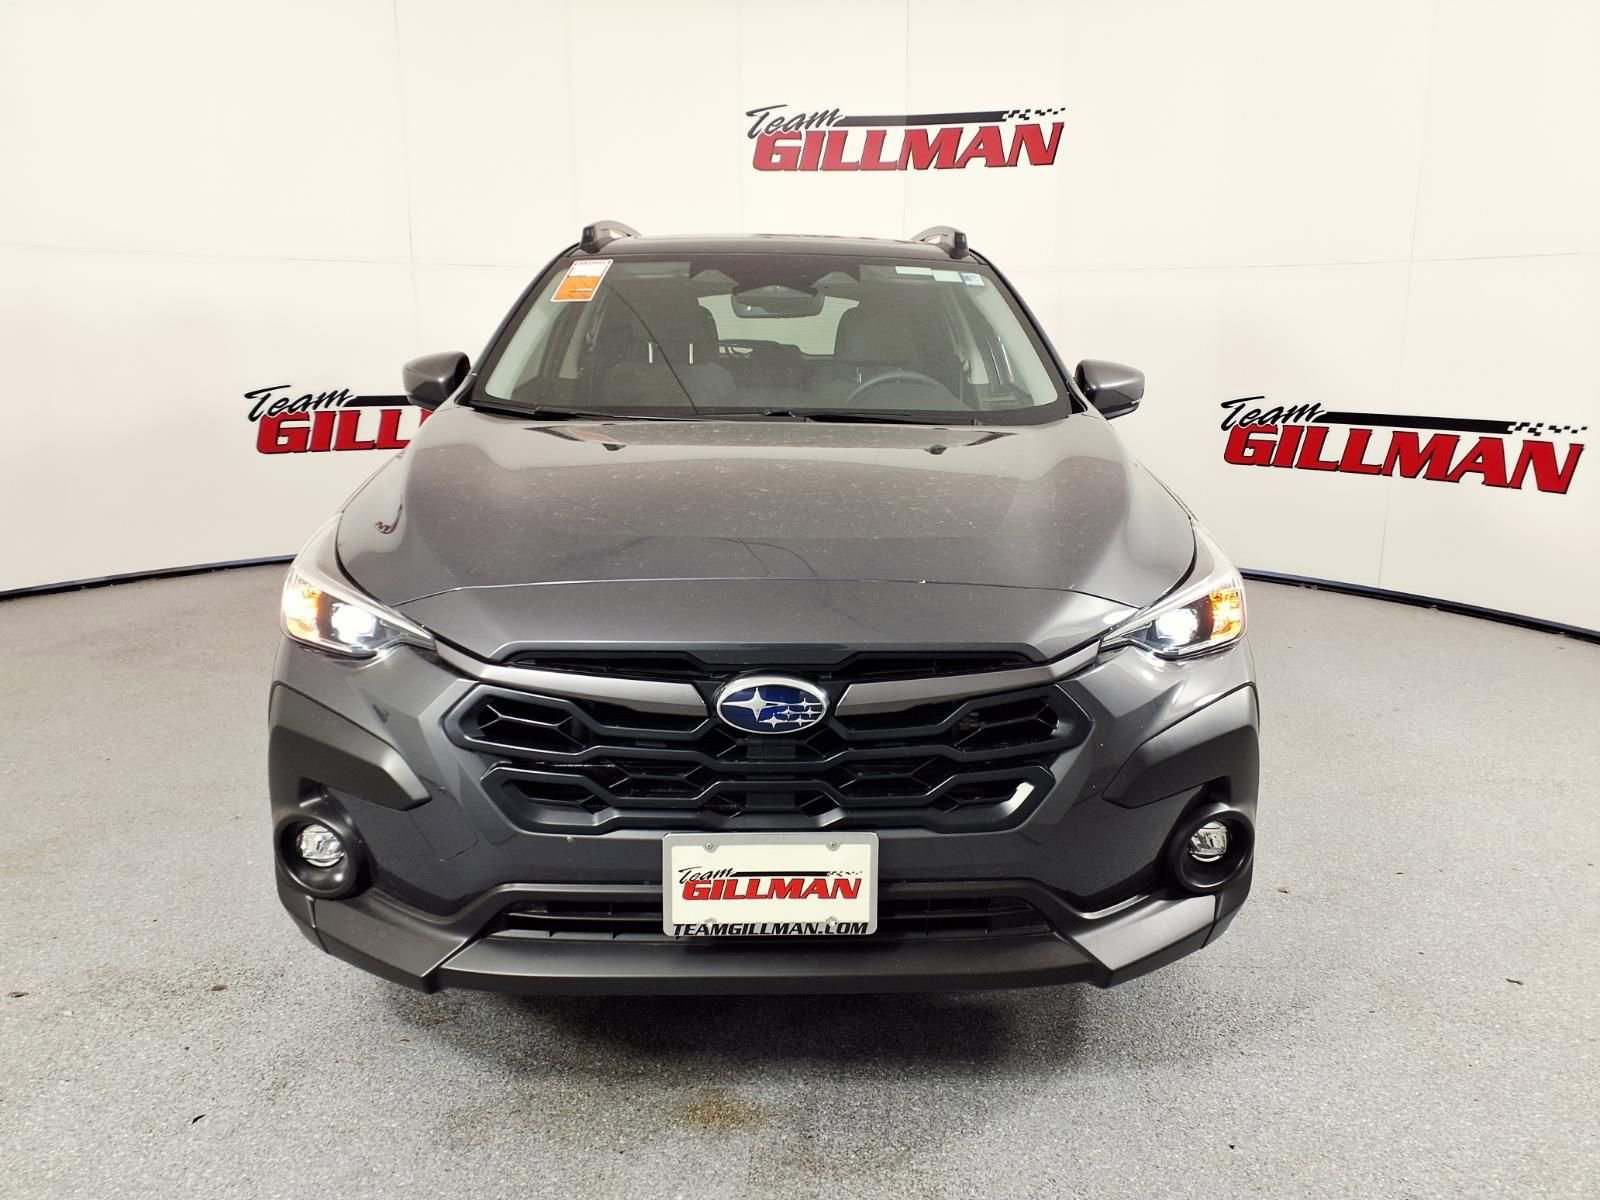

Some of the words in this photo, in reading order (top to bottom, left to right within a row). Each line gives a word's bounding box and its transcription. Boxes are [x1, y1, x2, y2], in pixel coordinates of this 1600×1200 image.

[745, 104, 843, 139] Team
[752, 122, 1064, 171] GILLMAN
[244, 384, 353, 422] Team
[1220, 396, 1326, 431] Team
[256, 408, 433, 454] GILL
[1224, 423, 1585, 494] GILLMAN
[678, 866, 735, 884] Team
[682, 878, 862, 900] GILLMAN
[673, 922, 868, 936] TEAMGILLMAN.COM
